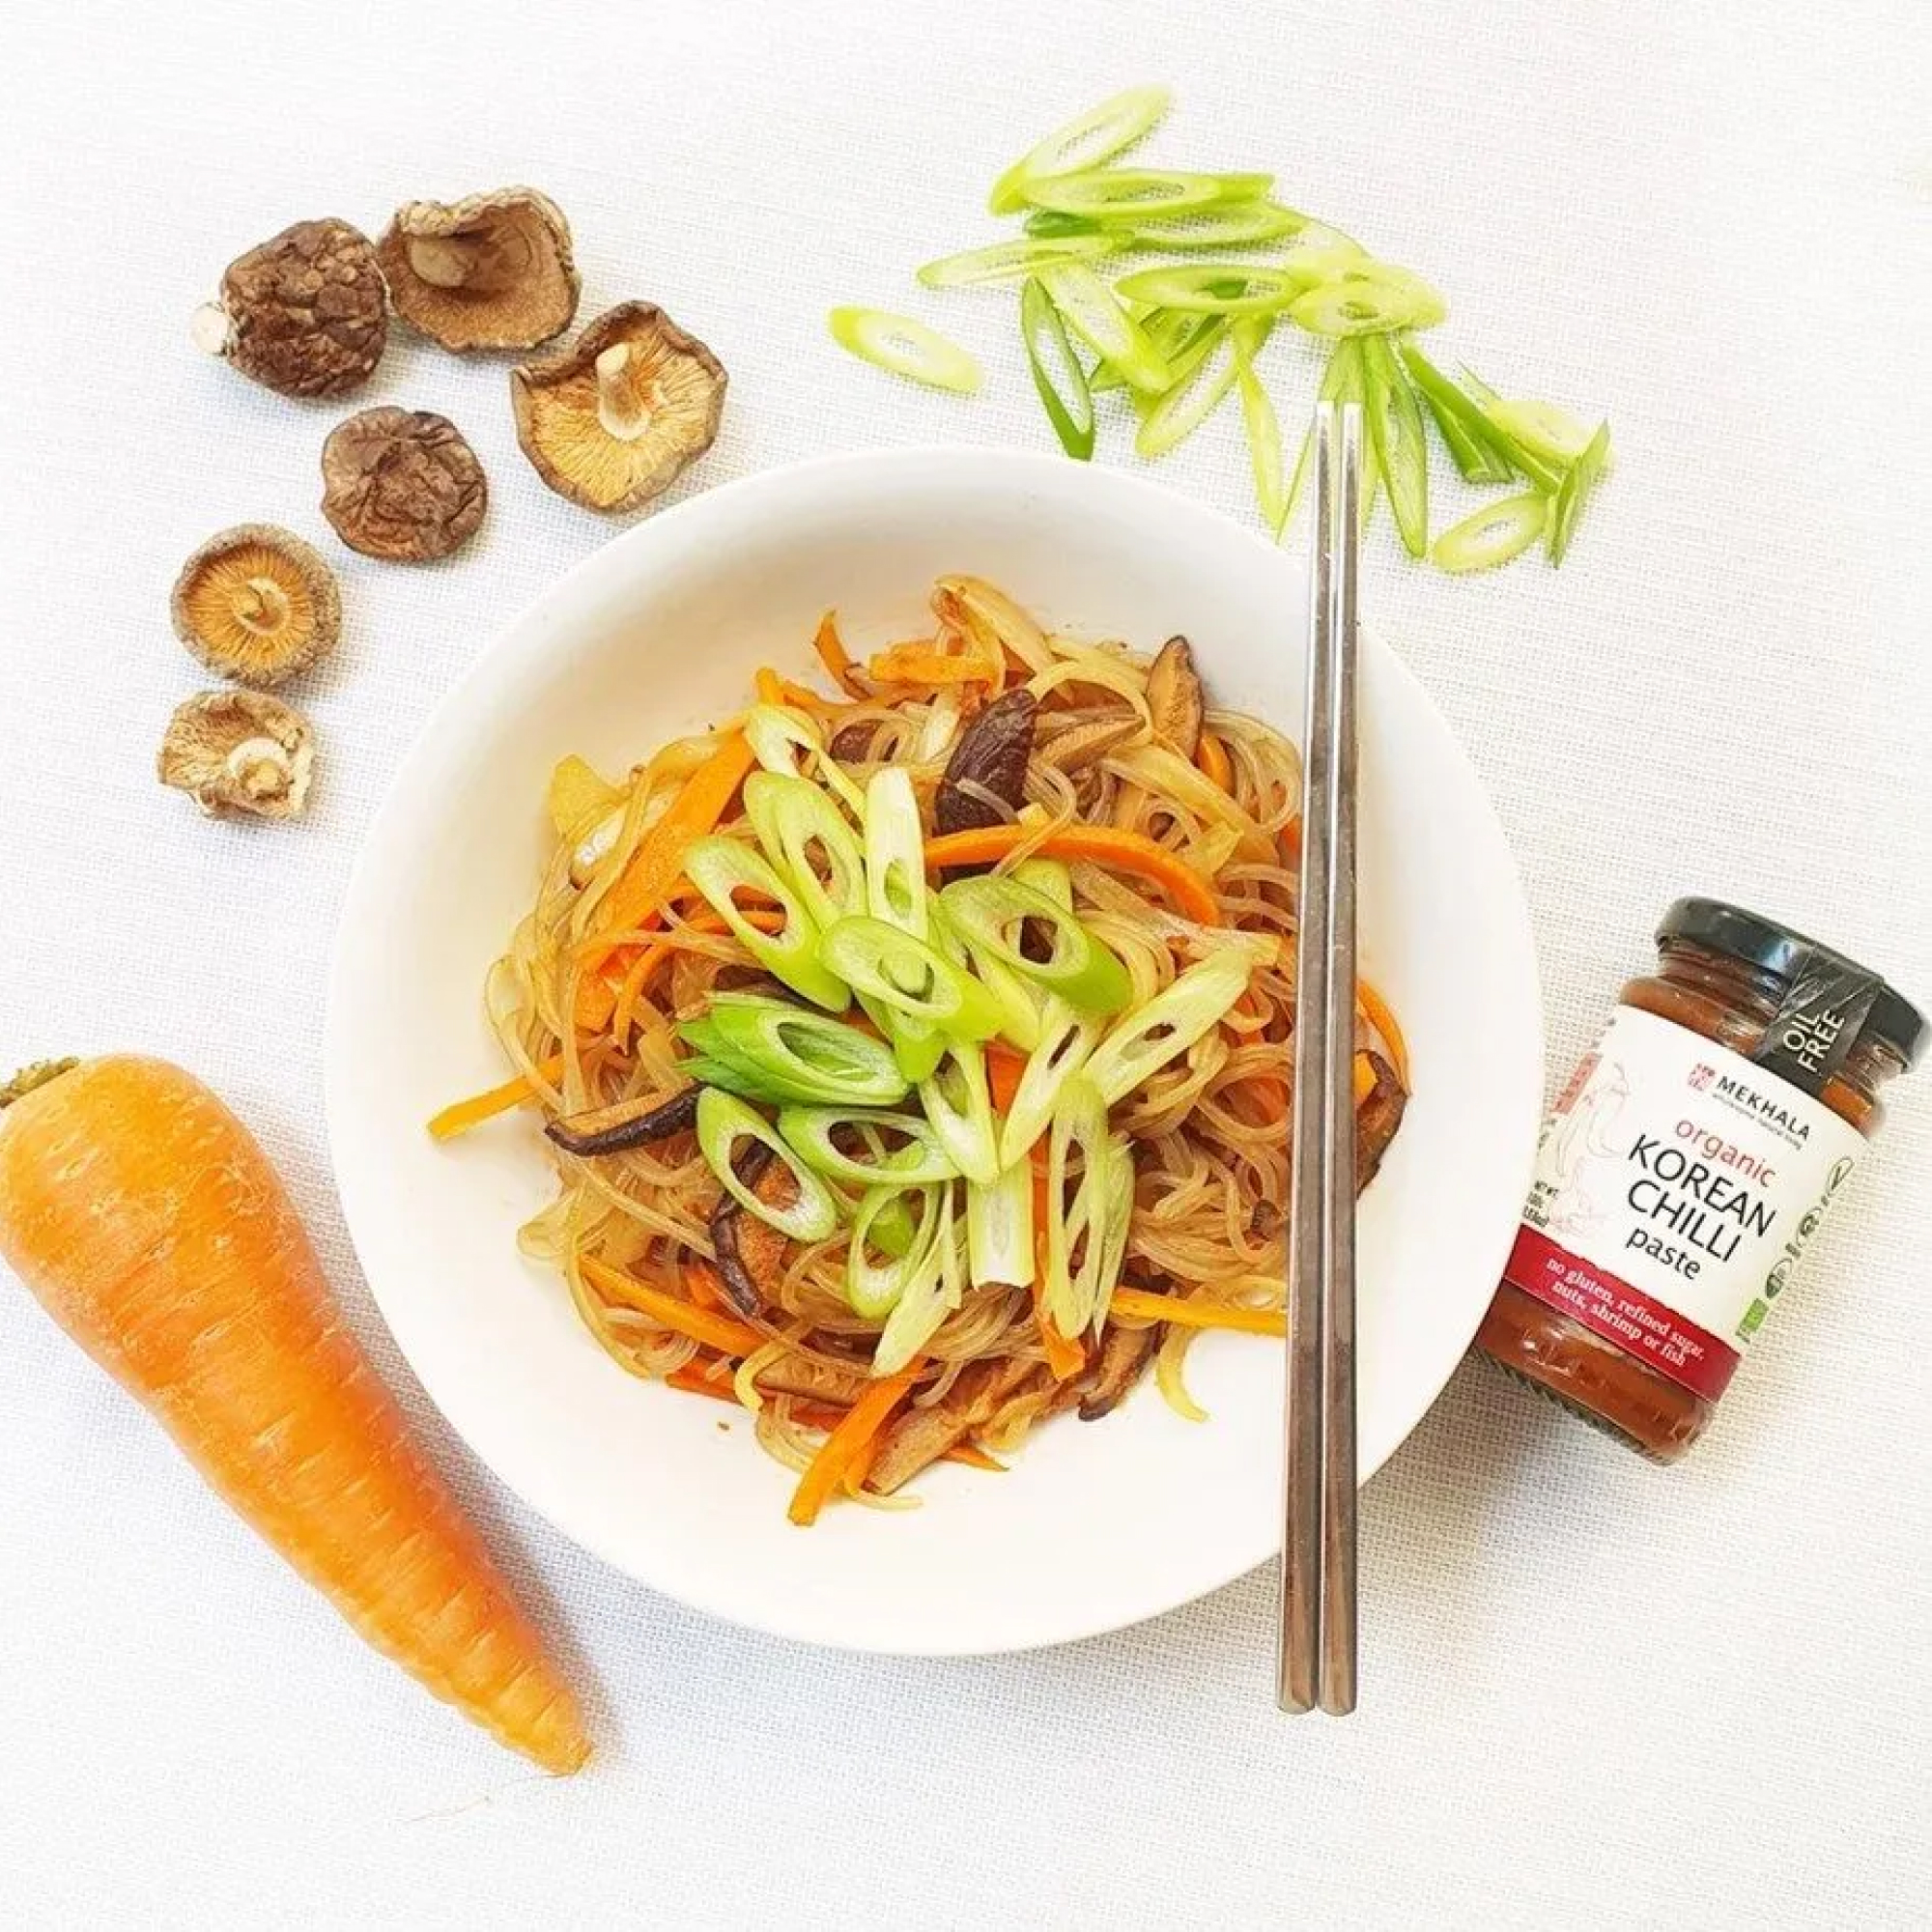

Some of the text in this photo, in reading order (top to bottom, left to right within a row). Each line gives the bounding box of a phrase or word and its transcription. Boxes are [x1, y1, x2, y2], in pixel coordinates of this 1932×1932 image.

[1783, 1013, 1821, 1051] OIL
[1797, 1009, 1845, 1073] FREE
[1716, 1075, 1810, 1141] MEKHALA
[1628, 1133, 1777, 1238] KOREAN
[1675, 1119, 1776, 1188] organic
[1626, 1228, 1701, 1281] paste
[1628, 1179, 1742, 1263] CHILLI
[1547, 1258, 1566, 1276] no
[1564, 1270, 1615, 1308] gluten,
[1617, 1299, 1672, 1337] refined
[1670, 1331, 1705, 1361] sugar,
[1551, 1280, 1687, 1368] nuts, shrimp or fish
